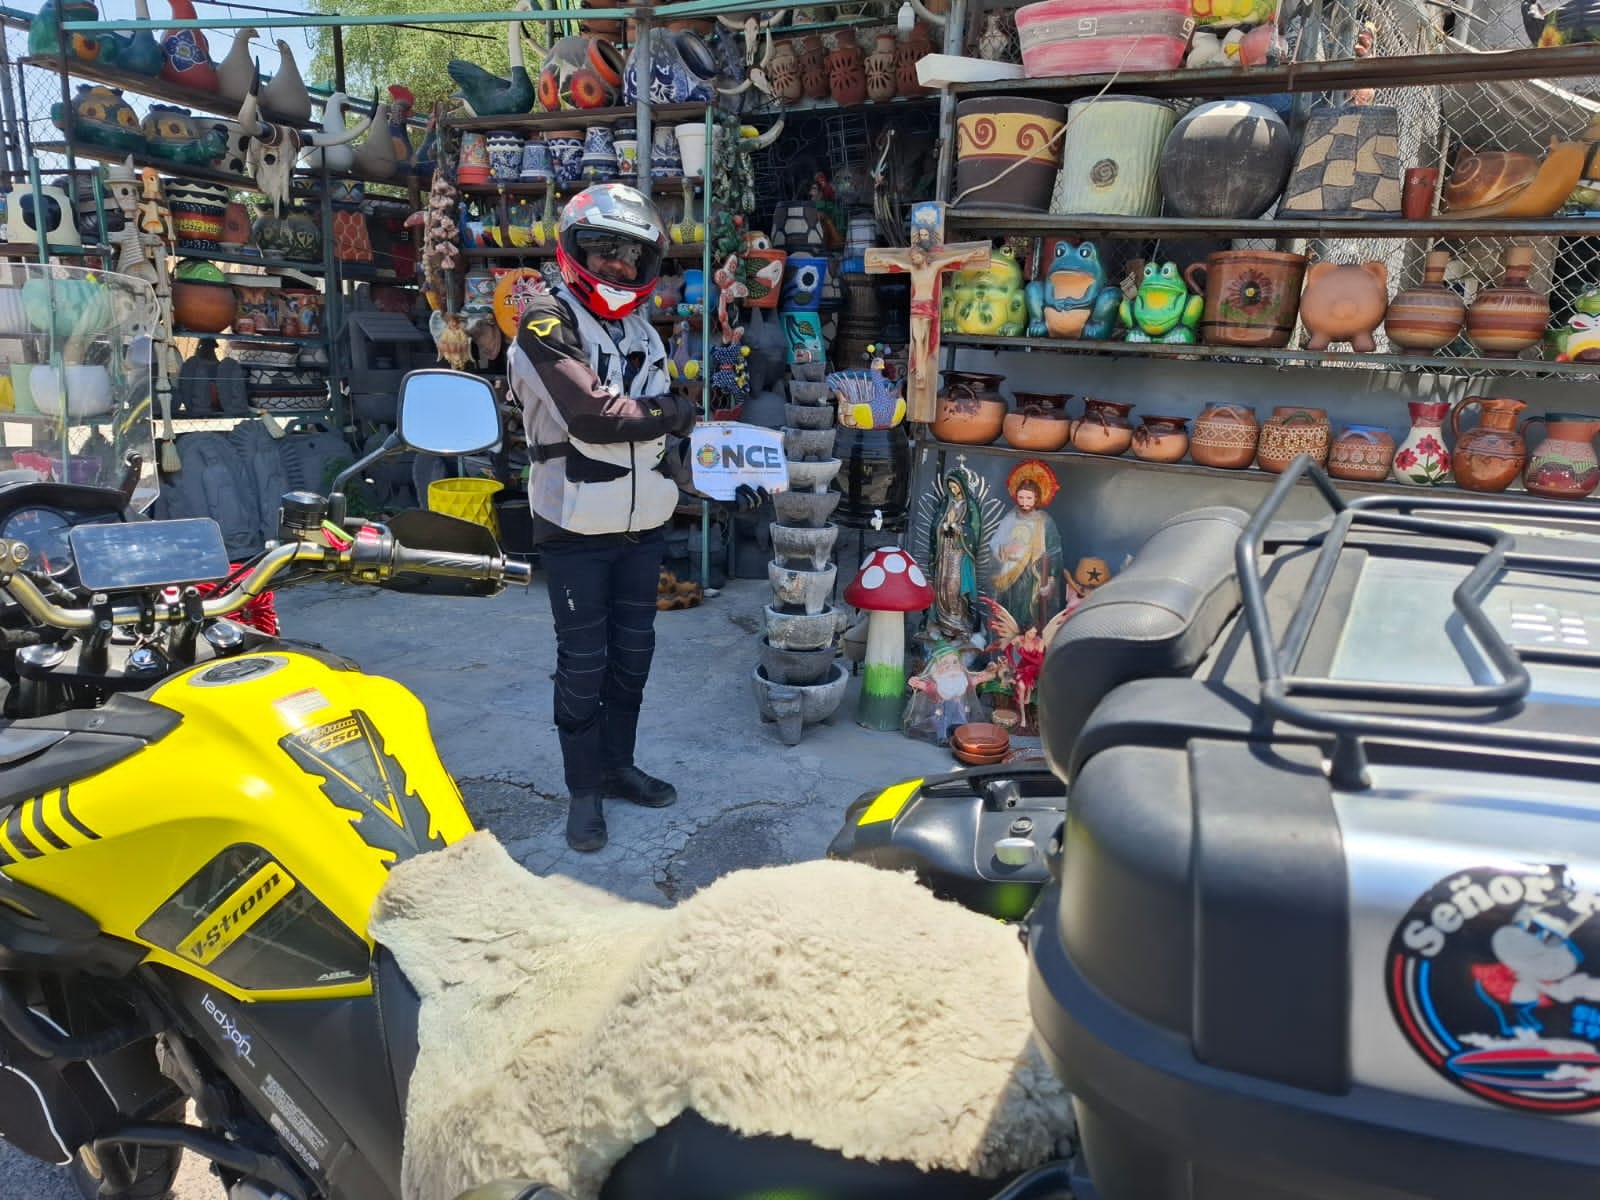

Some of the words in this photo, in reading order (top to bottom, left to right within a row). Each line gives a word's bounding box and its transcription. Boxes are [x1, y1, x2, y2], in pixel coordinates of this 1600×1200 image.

[697, 444, 781, 469] ONCE
[1403, 875, 1555, 957] Señor
[201, 992, 251, 1057] ledxon
